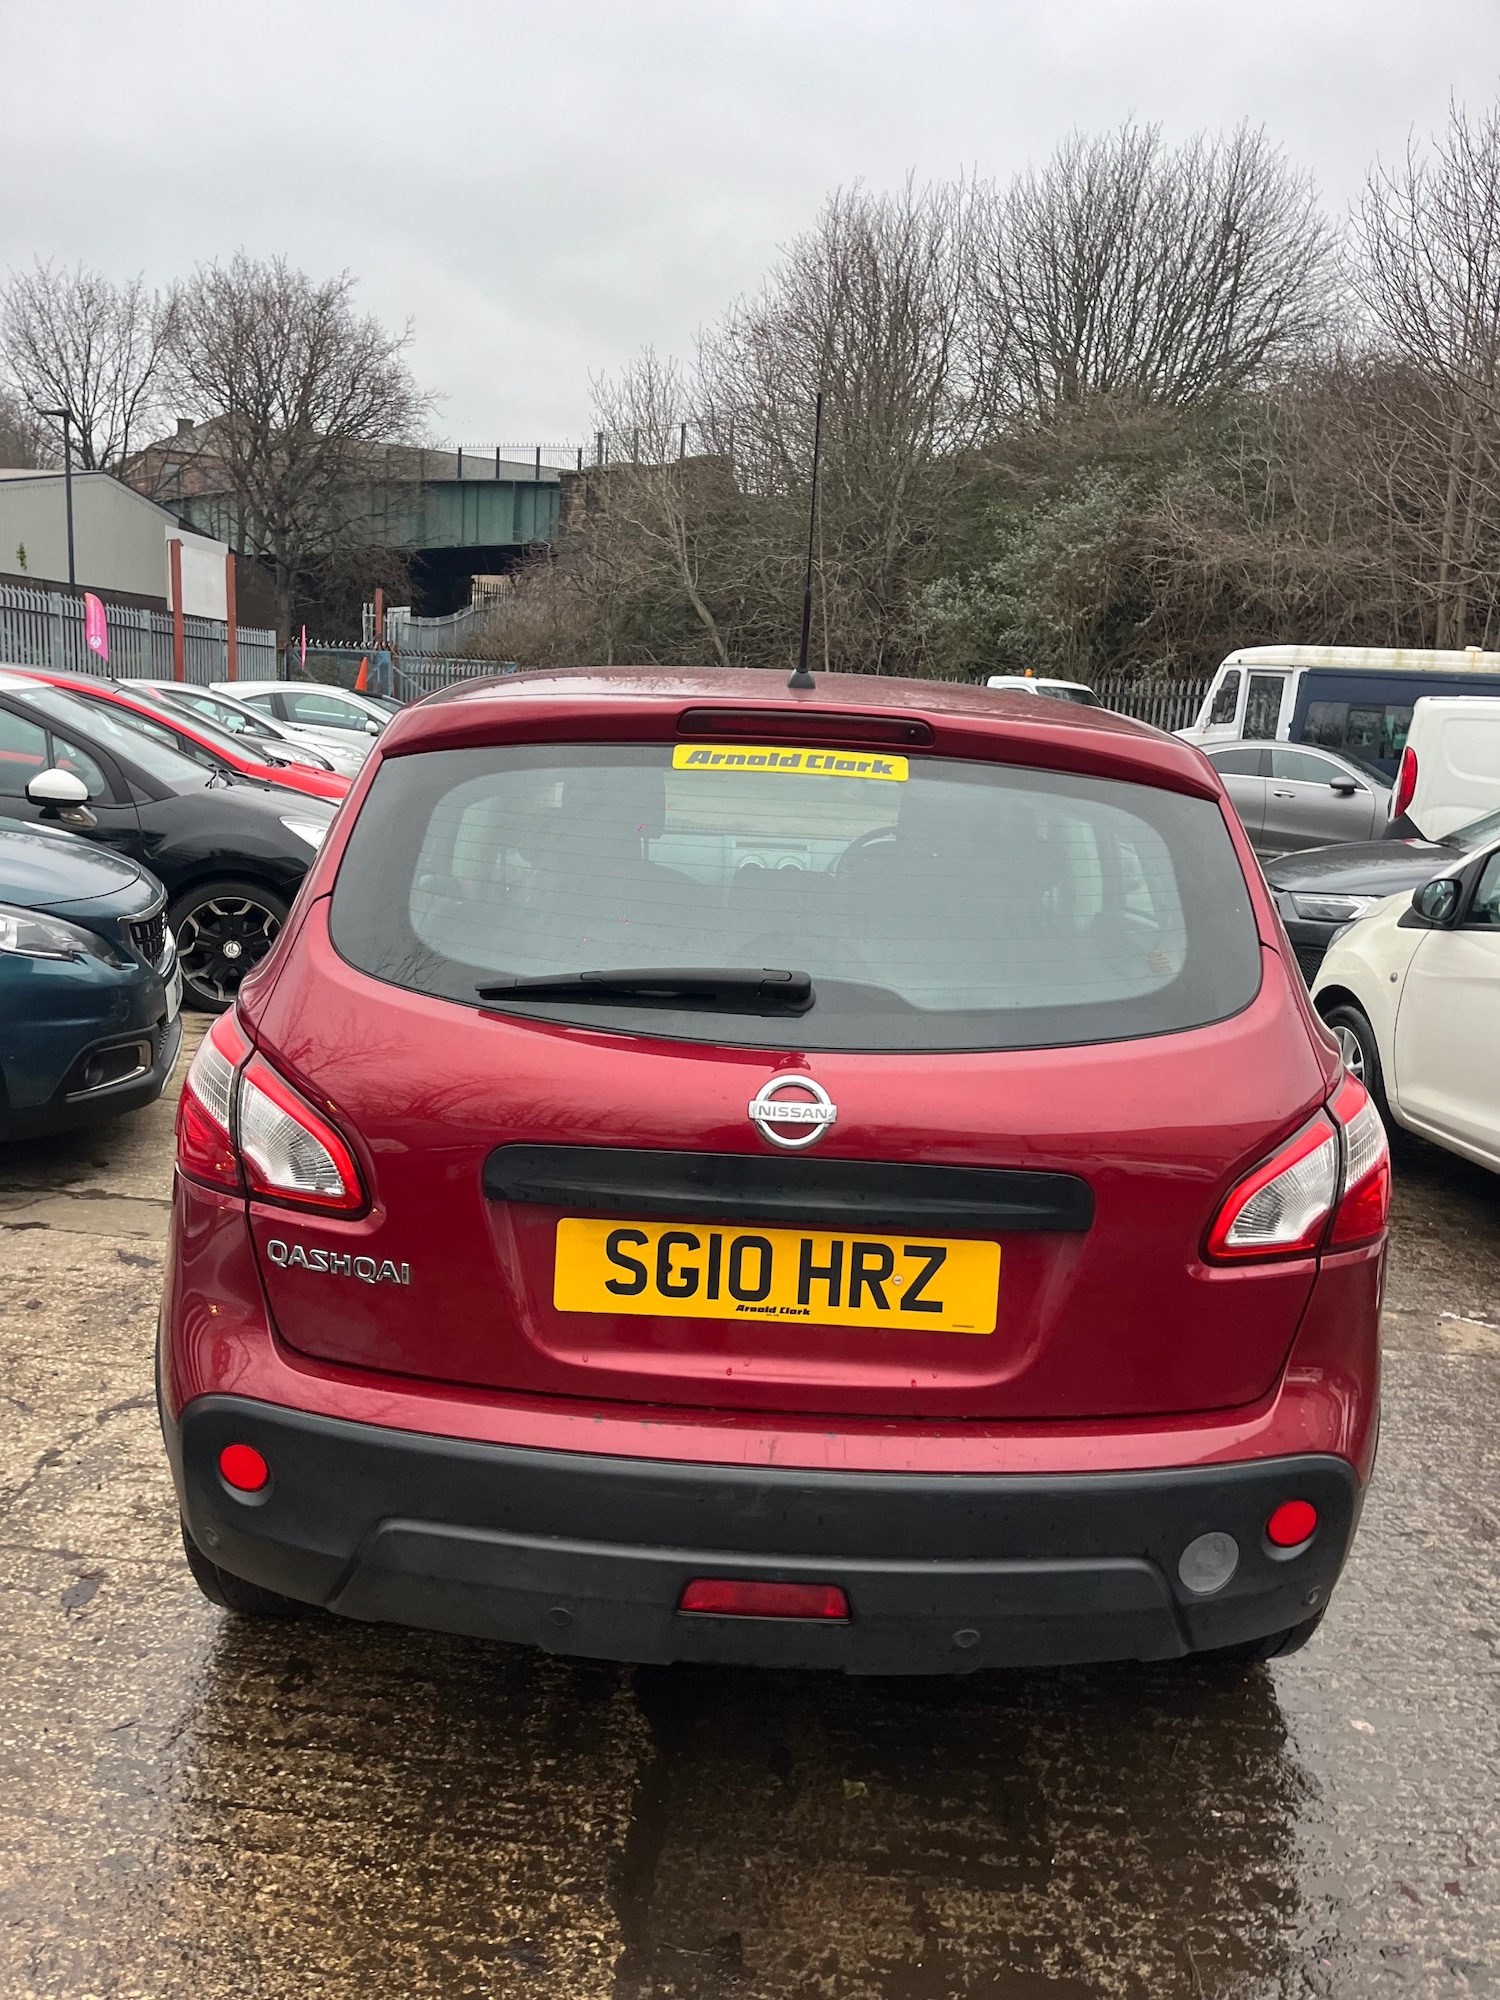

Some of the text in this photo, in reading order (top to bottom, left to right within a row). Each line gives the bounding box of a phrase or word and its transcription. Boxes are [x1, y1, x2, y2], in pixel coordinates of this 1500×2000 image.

[685, 750, 895, 775] Arnold Clark
[758, 1105, 828, 1119] NISSAN
[267, 1239, 410, 1285] QASHQAI
[604, 1228, 948, 1314] SG10 HRZ
[735, 1304, 811, 1316] Arnold Clark
